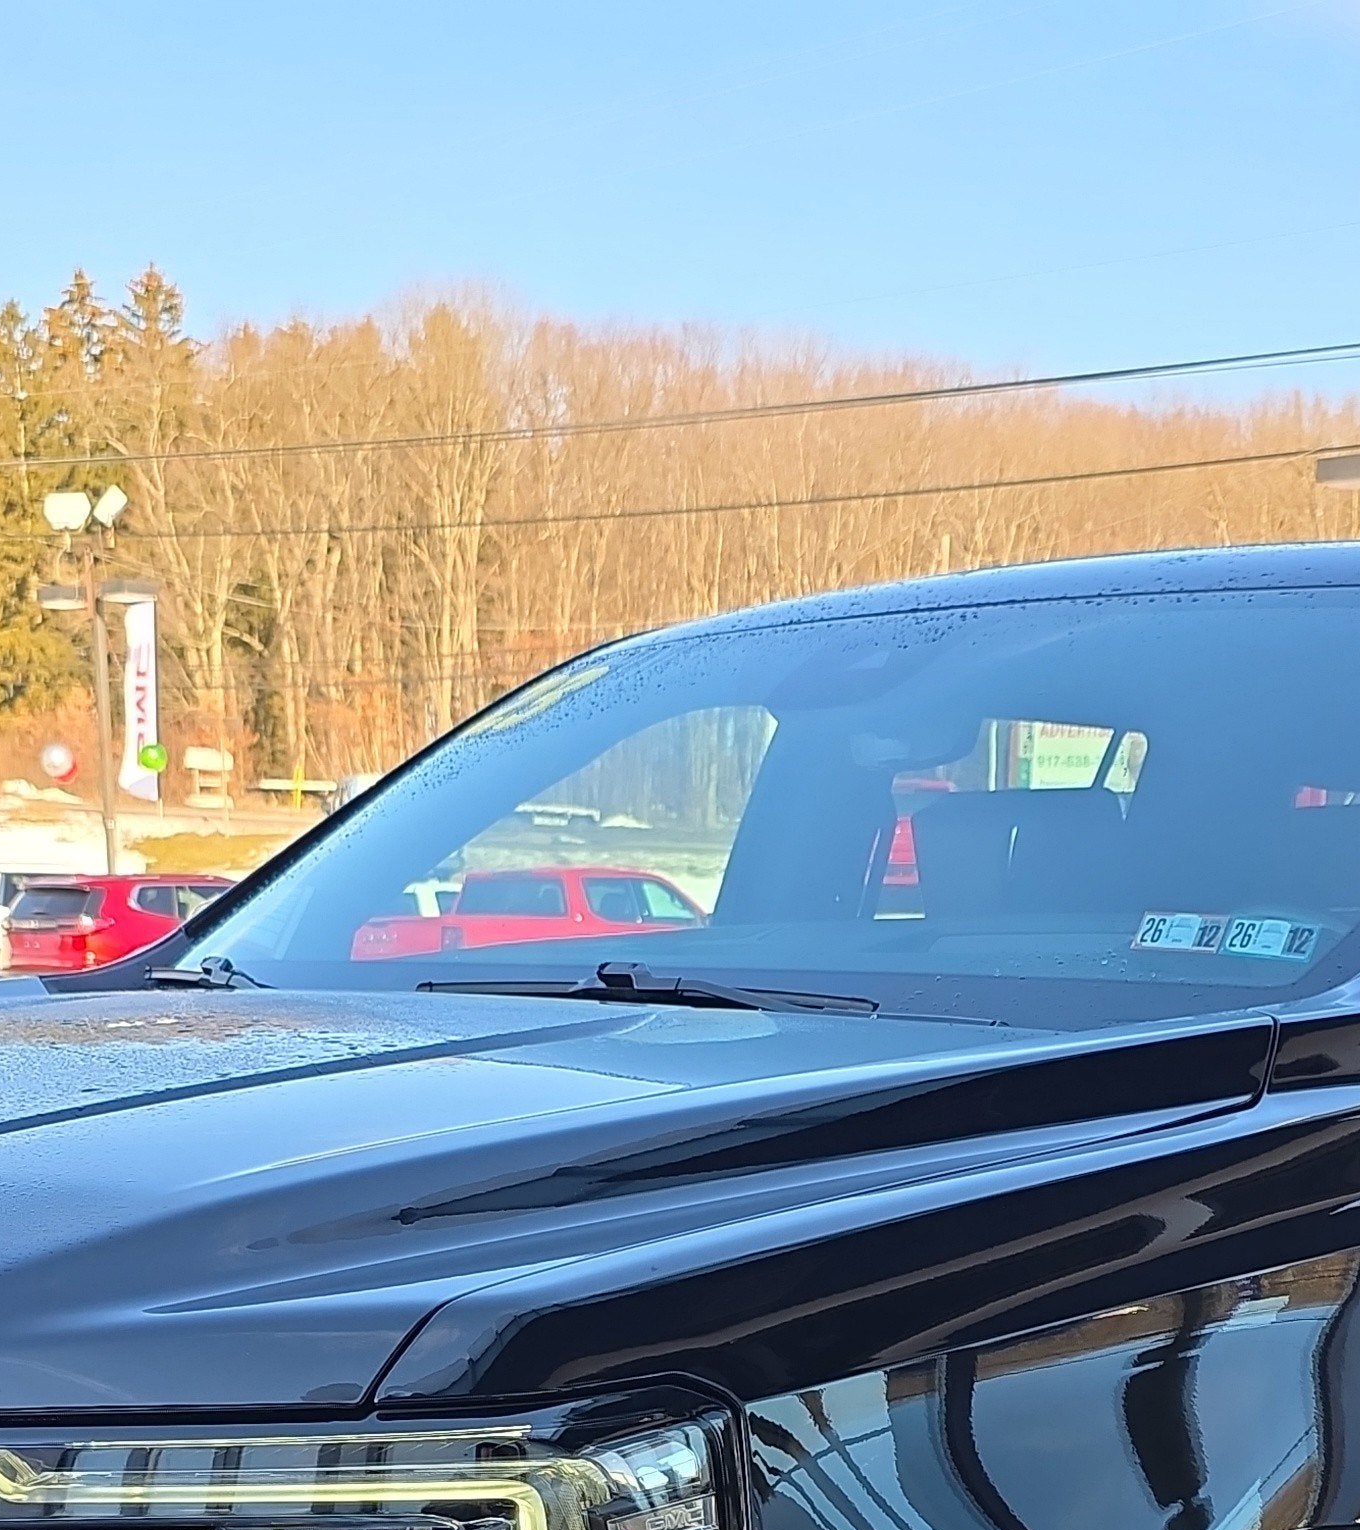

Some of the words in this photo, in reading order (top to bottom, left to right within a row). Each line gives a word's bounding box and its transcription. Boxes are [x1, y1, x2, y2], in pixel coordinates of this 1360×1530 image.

[1140, 917, 1167, 943] 26
[1193, 924, 1222, 948] 12
[1228, 922, 1256, 948] 26
[1283, 927, 1315, 955] 12
